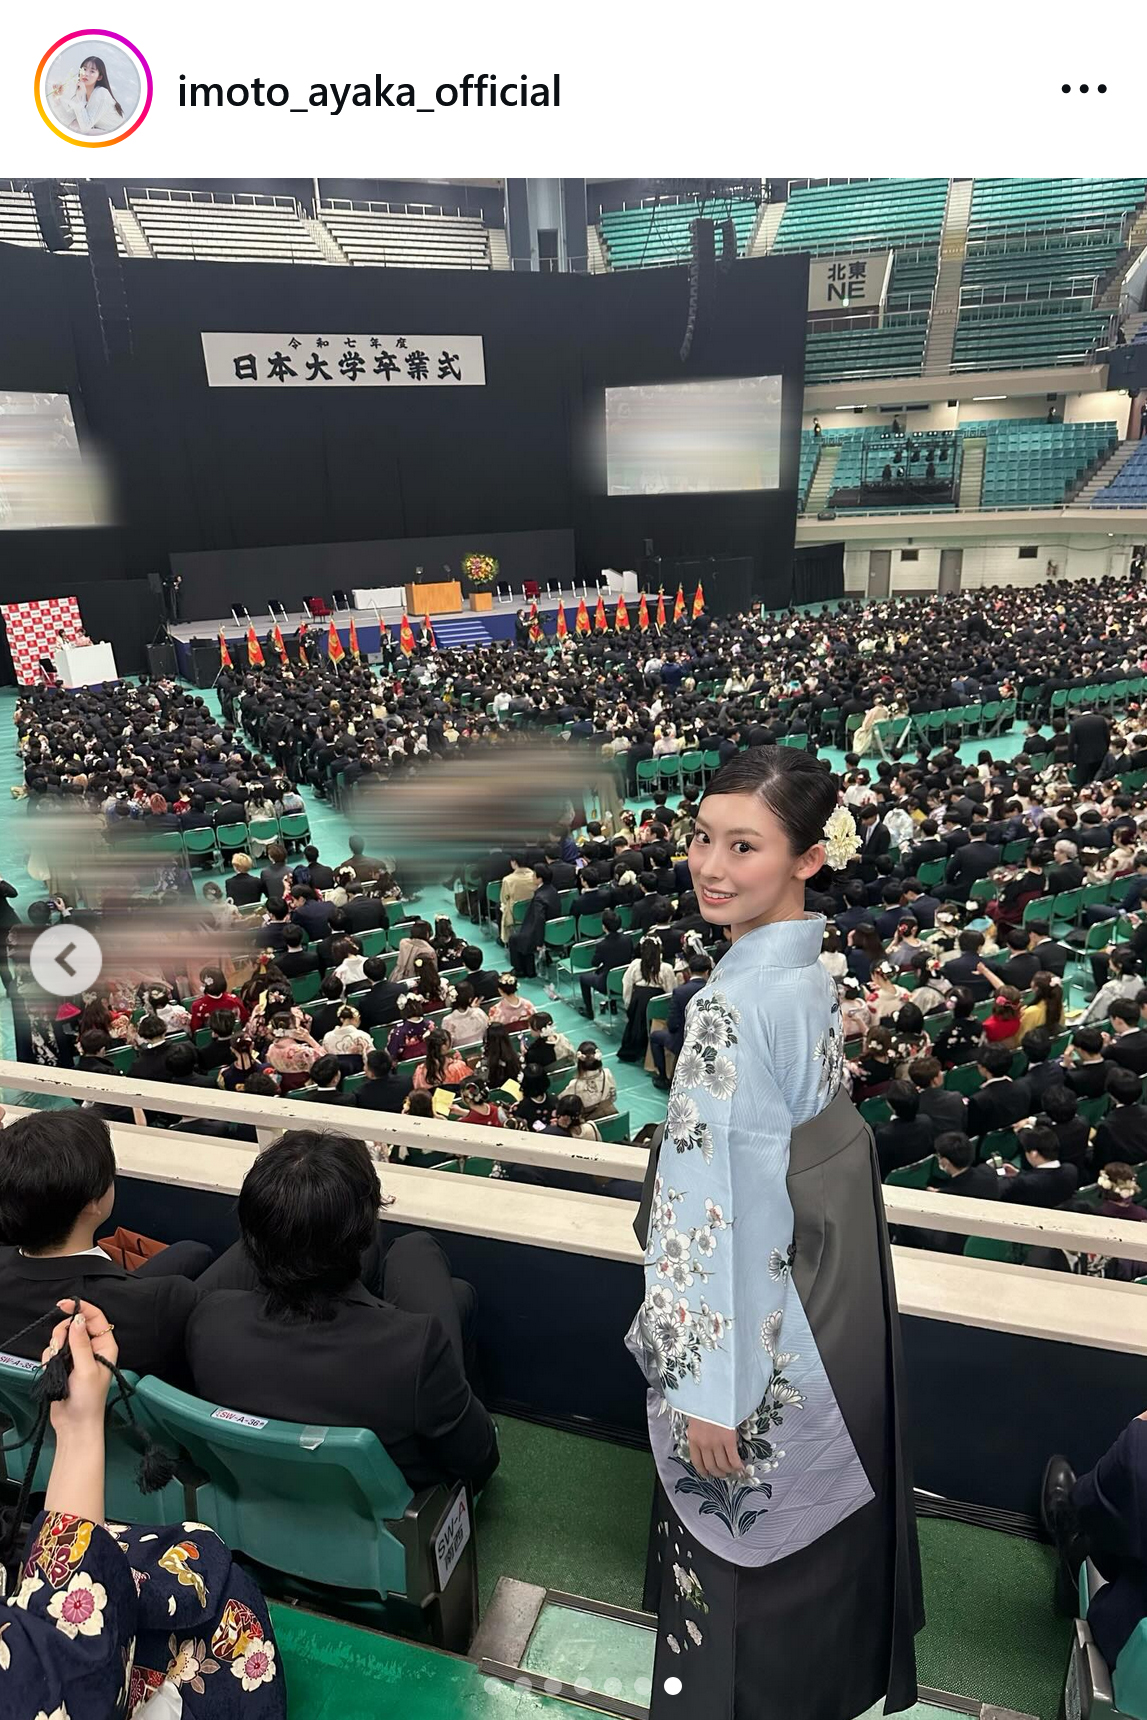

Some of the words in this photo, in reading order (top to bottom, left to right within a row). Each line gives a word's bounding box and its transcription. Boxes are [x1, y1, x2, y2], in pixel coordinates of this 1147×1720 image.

[827, 261, 867, 281] 北東
[827, 280, 866, 301] NE
[288, 337, 408, 350] 令和七年度
[233, 350, 462, 382] 日本大学卒業式
